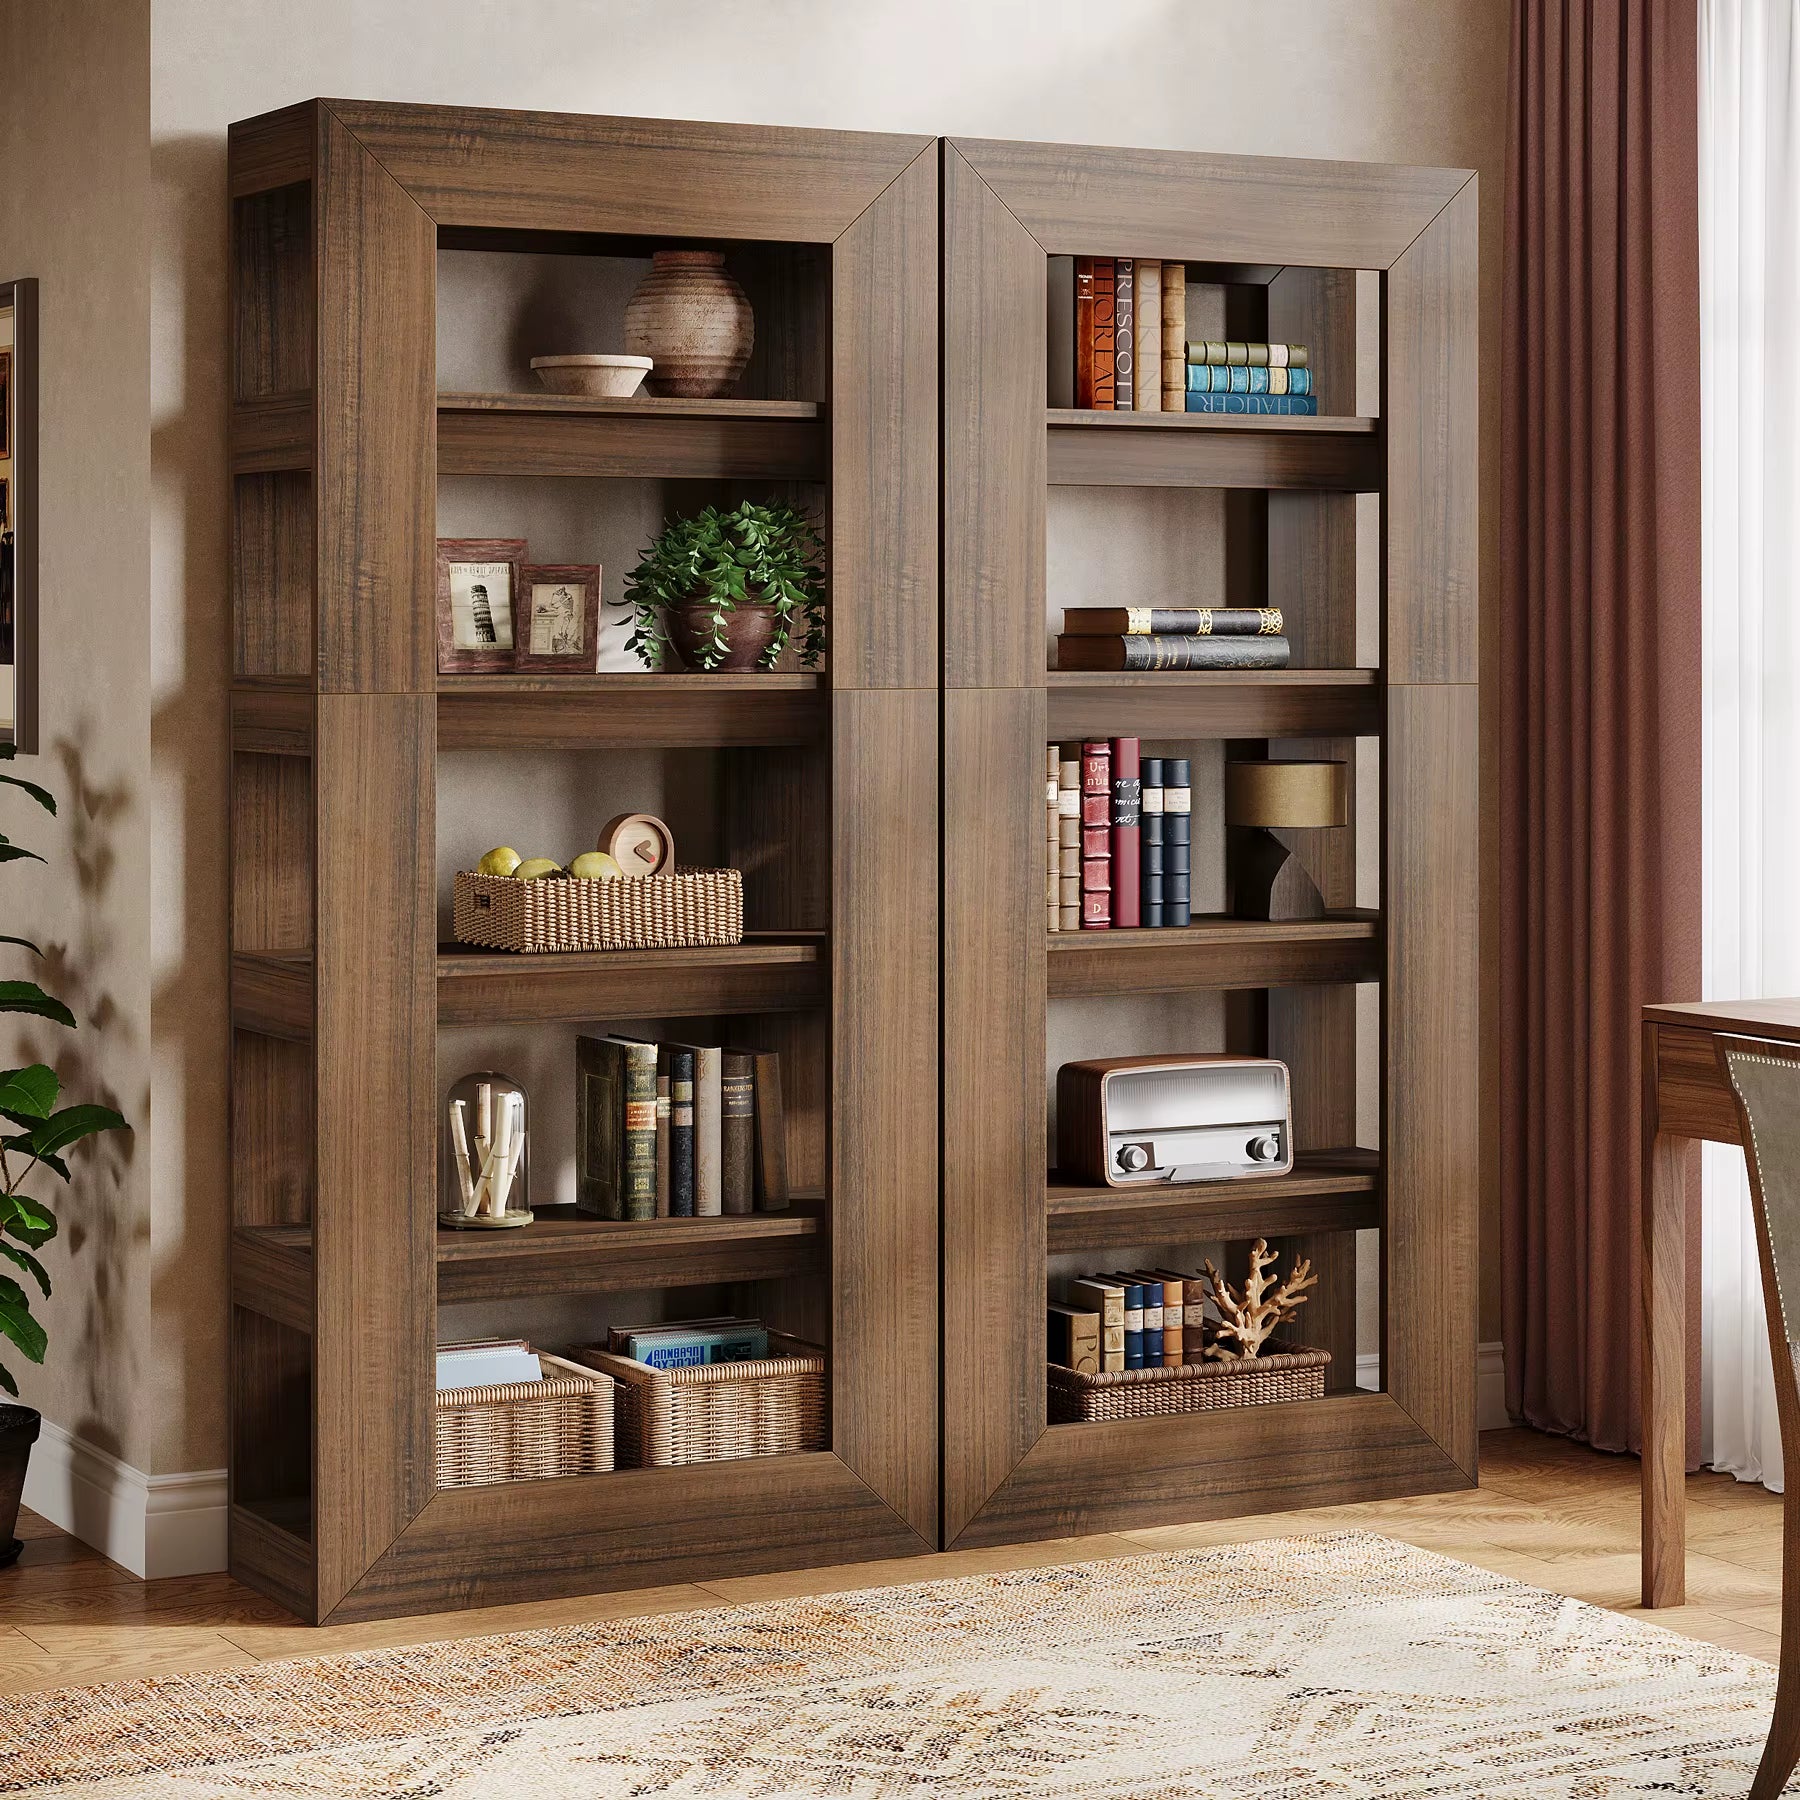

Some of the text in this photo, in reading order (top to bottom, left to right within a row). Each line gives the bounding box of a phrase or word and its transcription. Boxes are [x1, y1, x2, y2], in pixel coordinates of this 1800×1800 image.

[1094, 258, 1114, 406] THOREAU
[1116, 258, 1133, 411] PRESCOTT
[1138, 263, 1160, 409] DICKENS
[1195, 395, 1310, 415] CHAUCER
[1092, 903, 1102, 914] D
